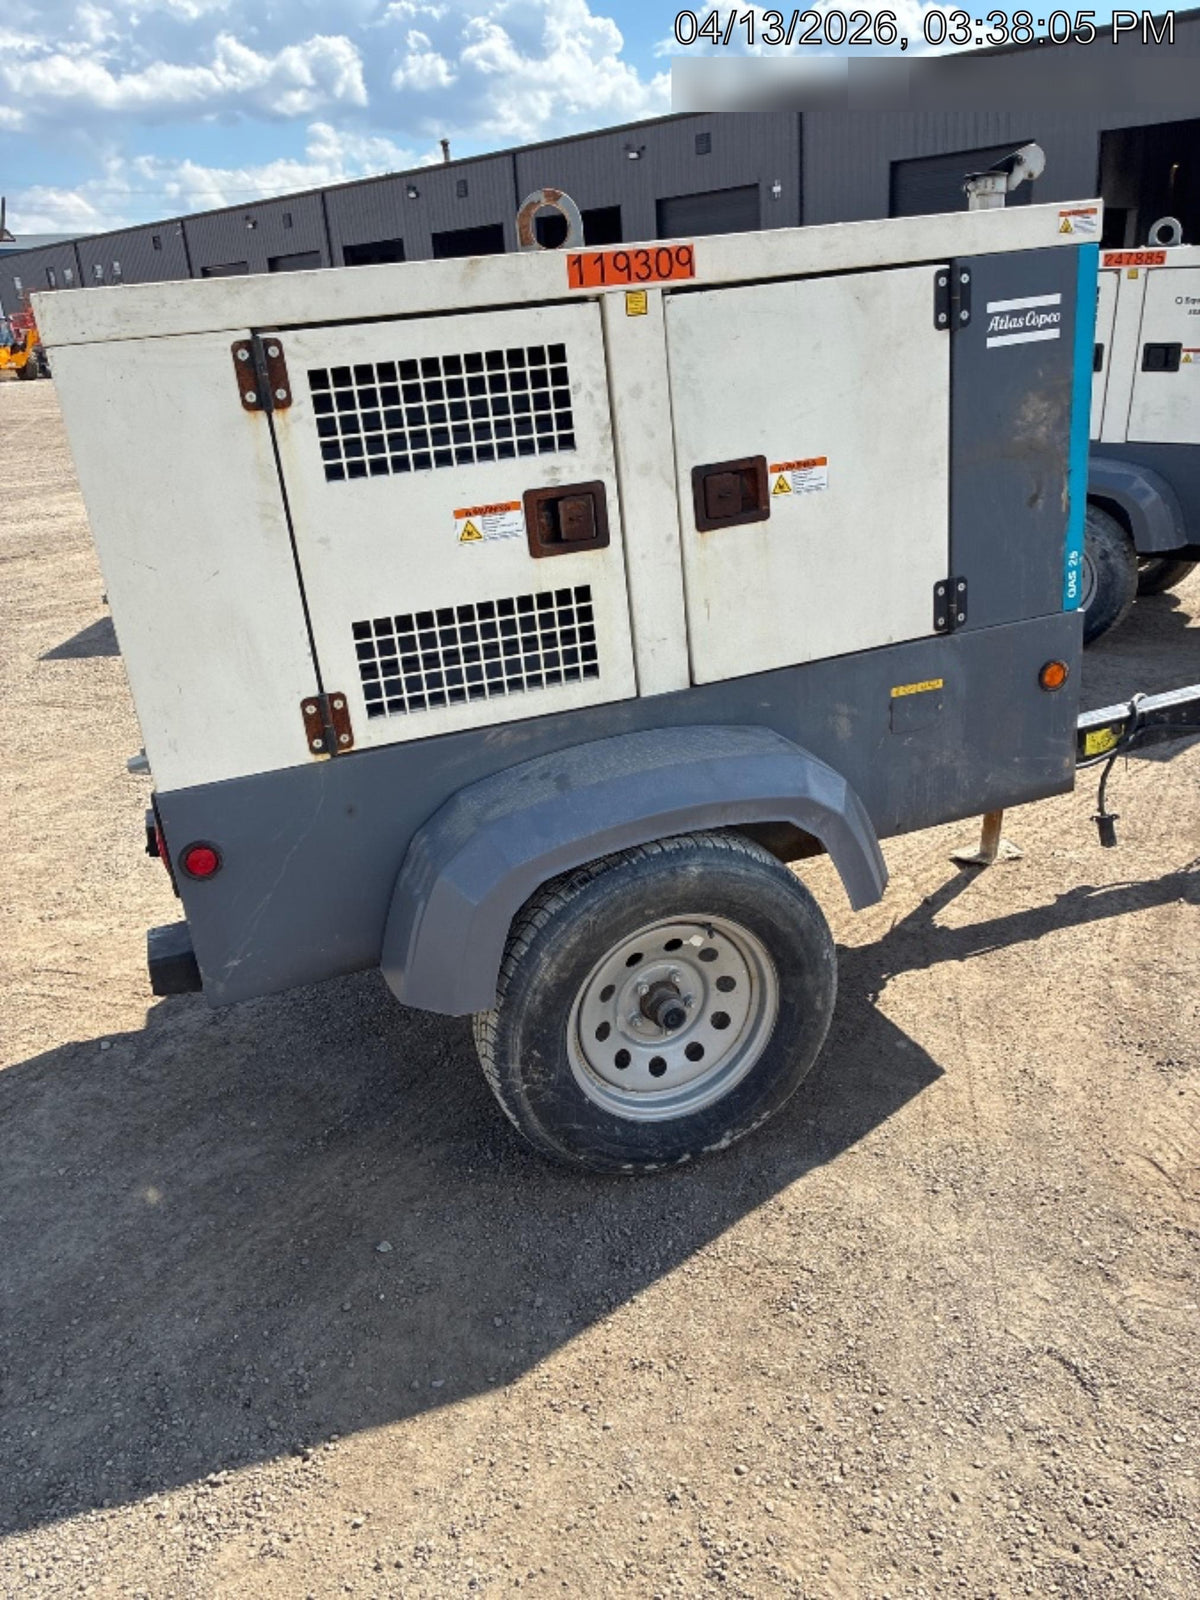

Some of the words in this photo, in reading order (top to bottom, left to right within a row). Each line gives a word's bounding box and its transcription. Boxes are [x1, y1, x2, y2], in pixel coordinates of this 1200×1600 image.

[571, 245, 695, 285] 119309
[1103, 251, 1166, 266] 247885
[1067, 570, 1077, 598] QAS
